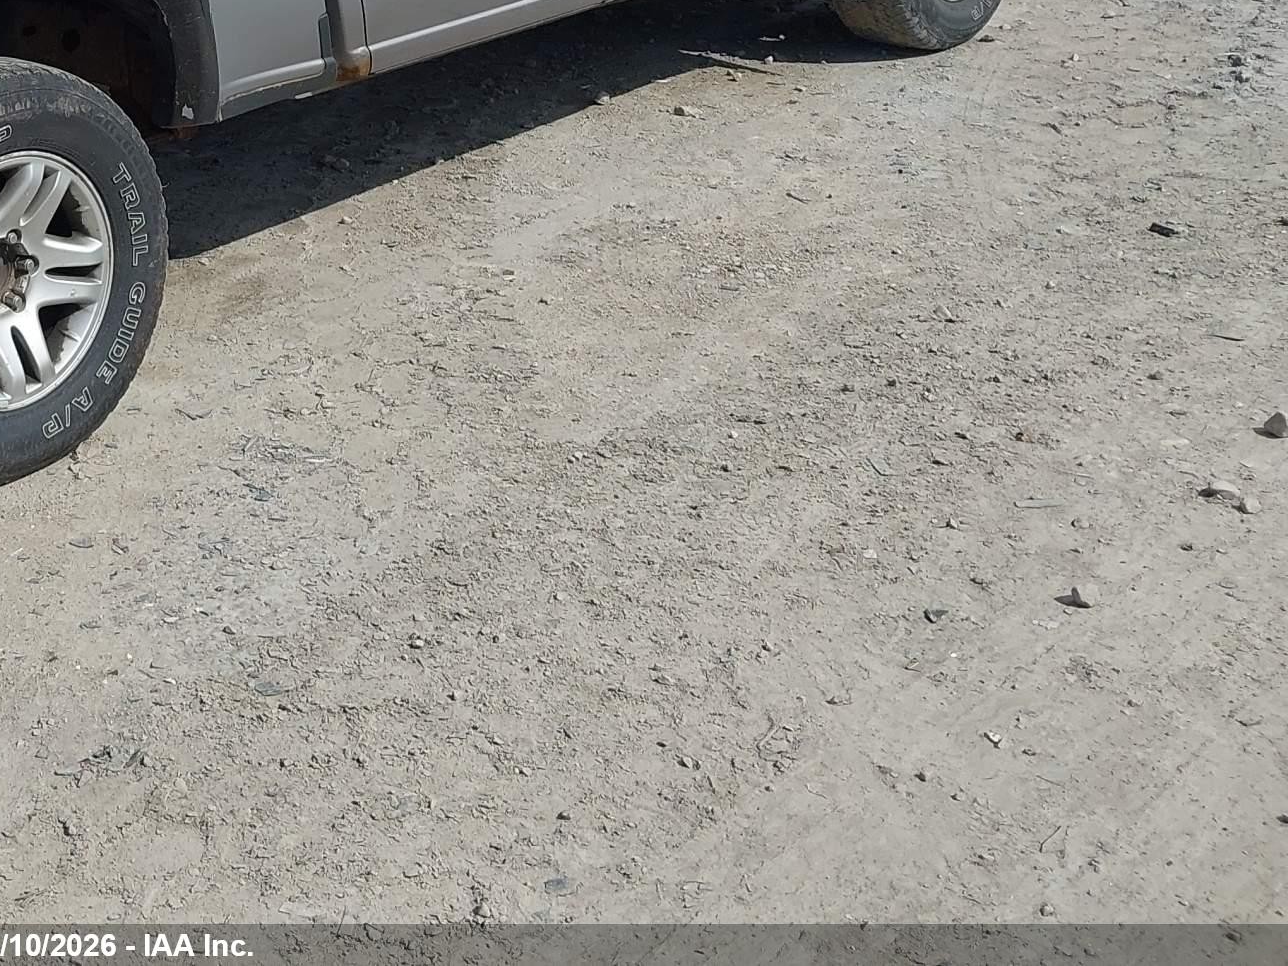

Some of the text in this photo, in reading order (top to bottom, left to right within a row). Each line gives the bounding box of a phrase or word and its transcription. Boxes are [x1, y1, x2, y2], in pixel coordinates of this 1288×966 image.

[42, 162, 149, 438] TRAIL GUIDE A/P
